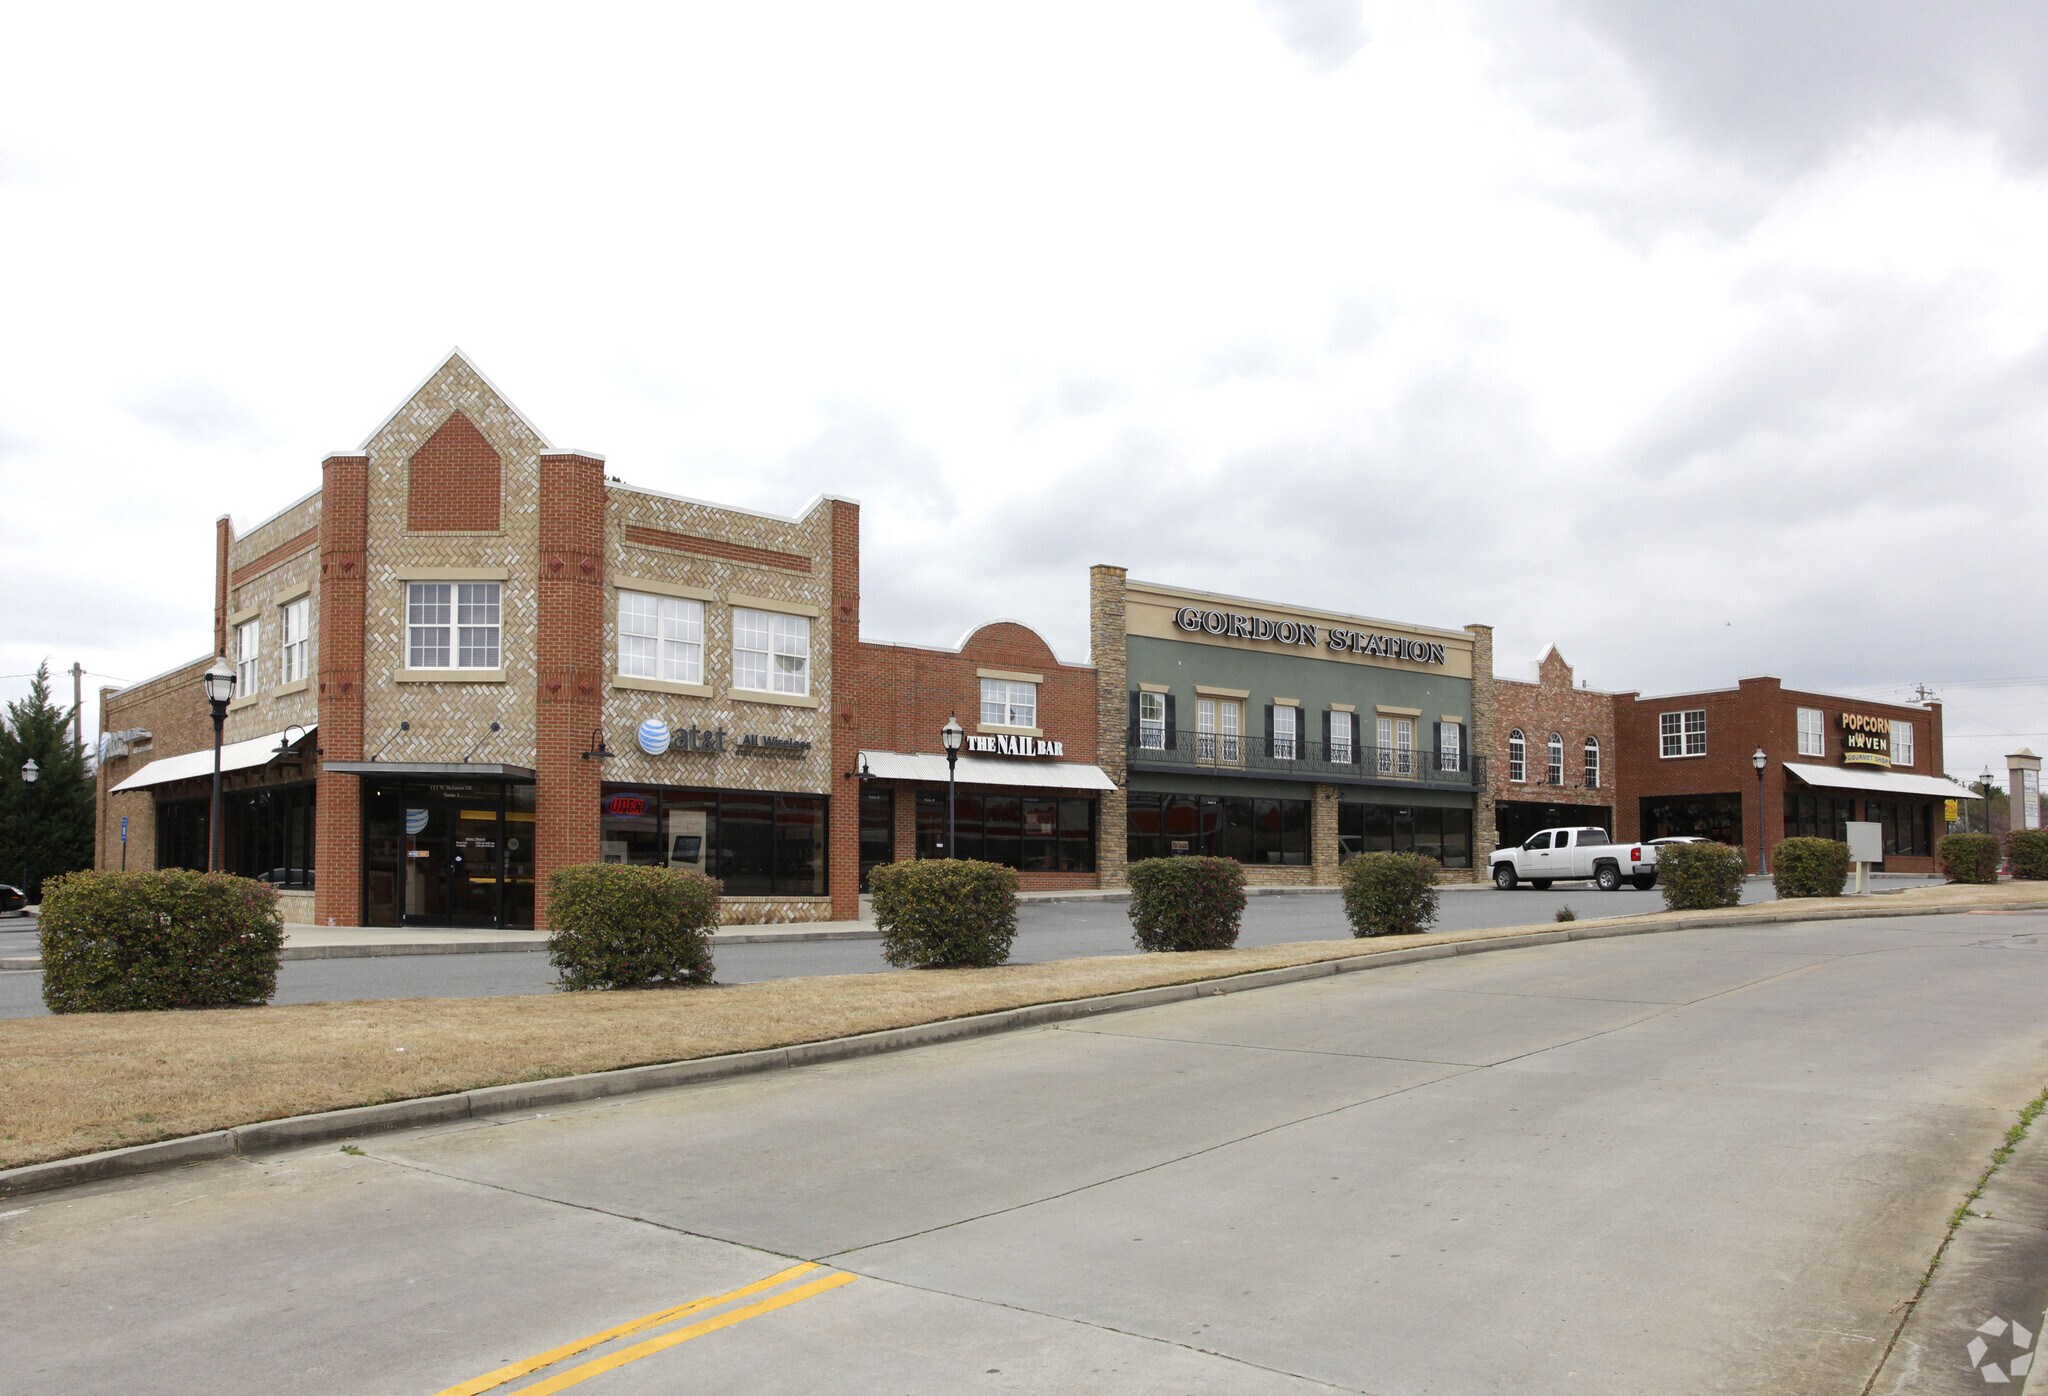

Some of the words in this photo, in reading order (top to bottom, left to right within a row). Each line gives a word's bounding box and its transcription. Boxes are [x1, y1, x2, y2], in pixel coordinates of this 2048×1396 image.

[1177, 606, 1320, 647] GORDON
[1328, 627, 1448, 665] STATION
[1842, 712, 1890, 733] POPCORN
[672, 724, 728, 753] at&t
[743, 734, 758, 747] All
[762, 735, 812, 751] Wireless
[966, 735, 996, 752] THE
[996, 734, 1036, 757] NAIL
[1037, 740, 1064, 757] BAR
[1848, 732, 1887, 750] HAVEN
[610, 797, 645, 815] OPEN
